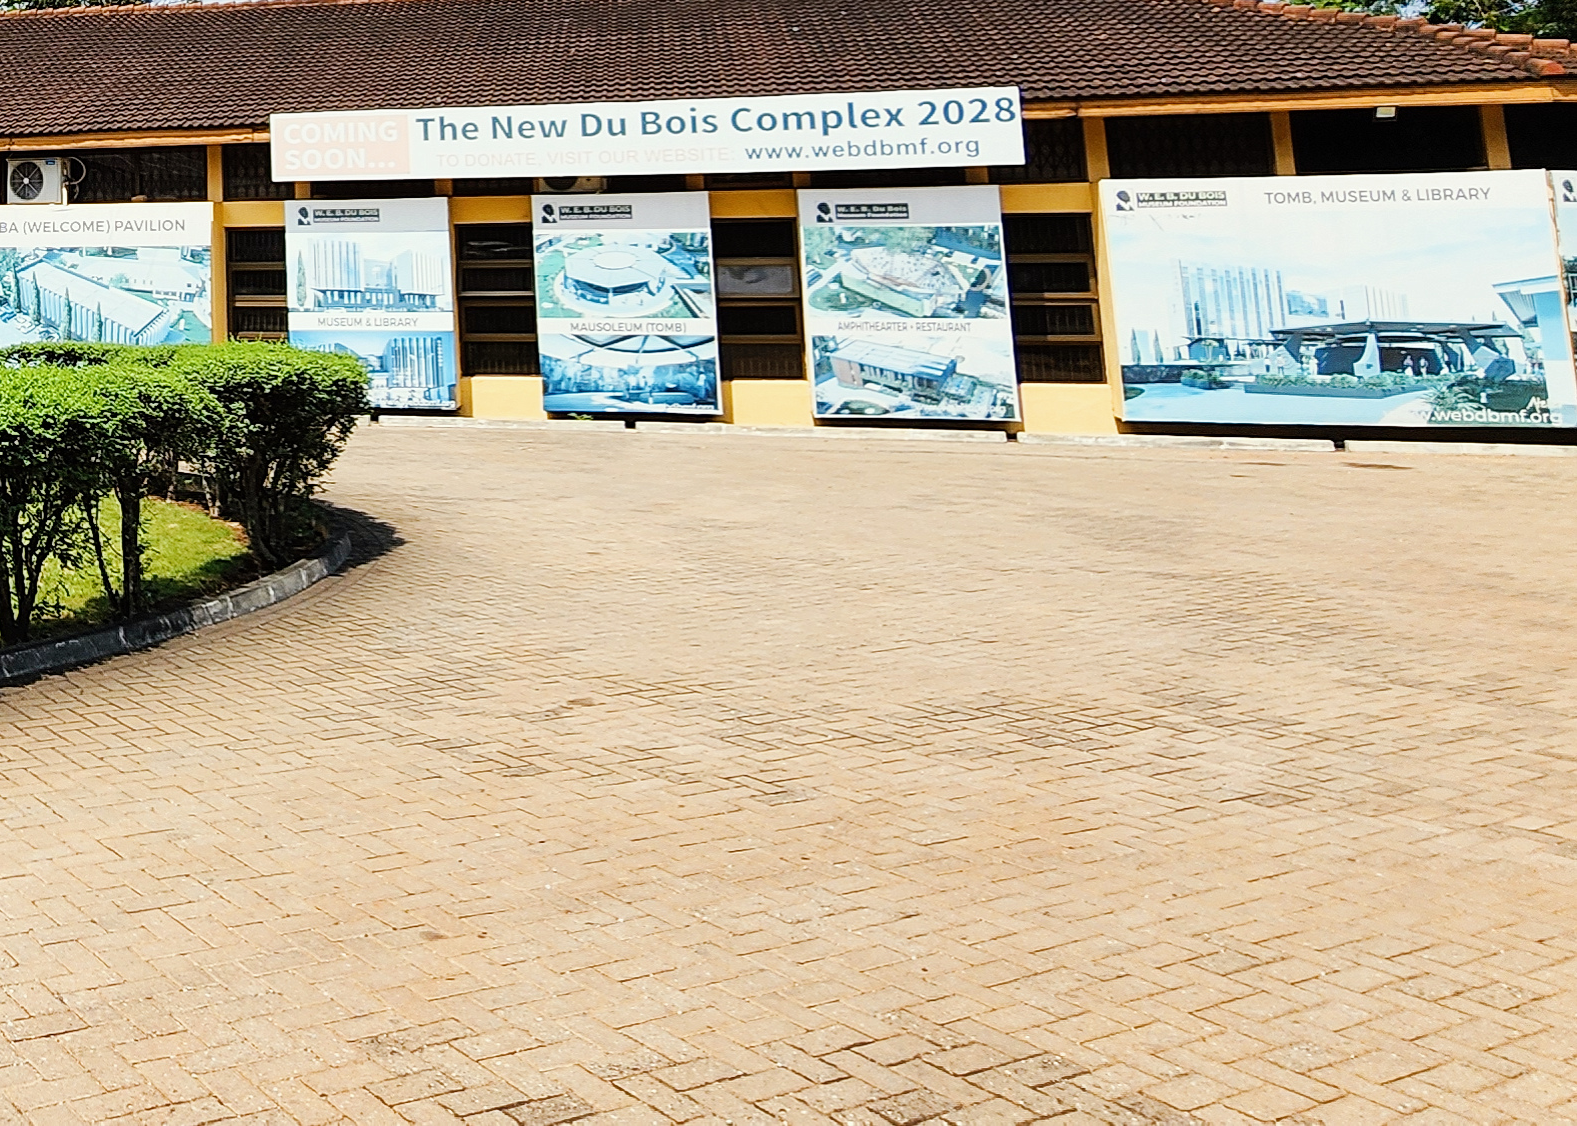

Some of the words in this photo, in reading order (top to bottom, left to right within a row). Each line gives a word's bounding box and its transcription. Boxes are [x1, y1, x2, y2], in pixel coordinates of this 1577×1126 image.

[416, 116, 479, 141] The
[491, 115, 568, 140] New
[580, 112, 627, 137] Du
[640, 107, 719, 135] Bois
[731, 102, 905, 136] Complex
[917, 97, 1016, 126] 2028
[283, 121, 399, 144] COMING
[436, 154, 460, 168] TO
[464, 152, 543, 167] DONATE,
[547, 150, 595, 165] VISIT
[598, 149, 639, 164] OUR
[645, 146, 736, 163] WEBSITE:
[745, 138, 980, 160] www.webdbmf.org
[284, 148, 396, 170] SOON...
[1264, 191, 1317, 205] TOMB,
[1321, 189, 1396, 204] MUSEUM
[1401, 189, 1412, 202] &
[1417, 187, 1490, 201] LIBRARY
[23, 220, 111, 235] (WELCOME)
[114, 219, 186, 232] PAVILION
[317, 317, 362, 327] MUSEUM
[365, 317, 372, 327] &
[374, 317, 418, 327] LIBRARY
[570, 322, 642, 332] MAUSOLEUM
[646, 322, 687, 333] (TOMB)
[838, 321, 908, 332] AMPHITHEARTER
[916, 322, 971, 332] RESTAURANT
[1407, 408, 1562, 426] w.webdbmf.org
